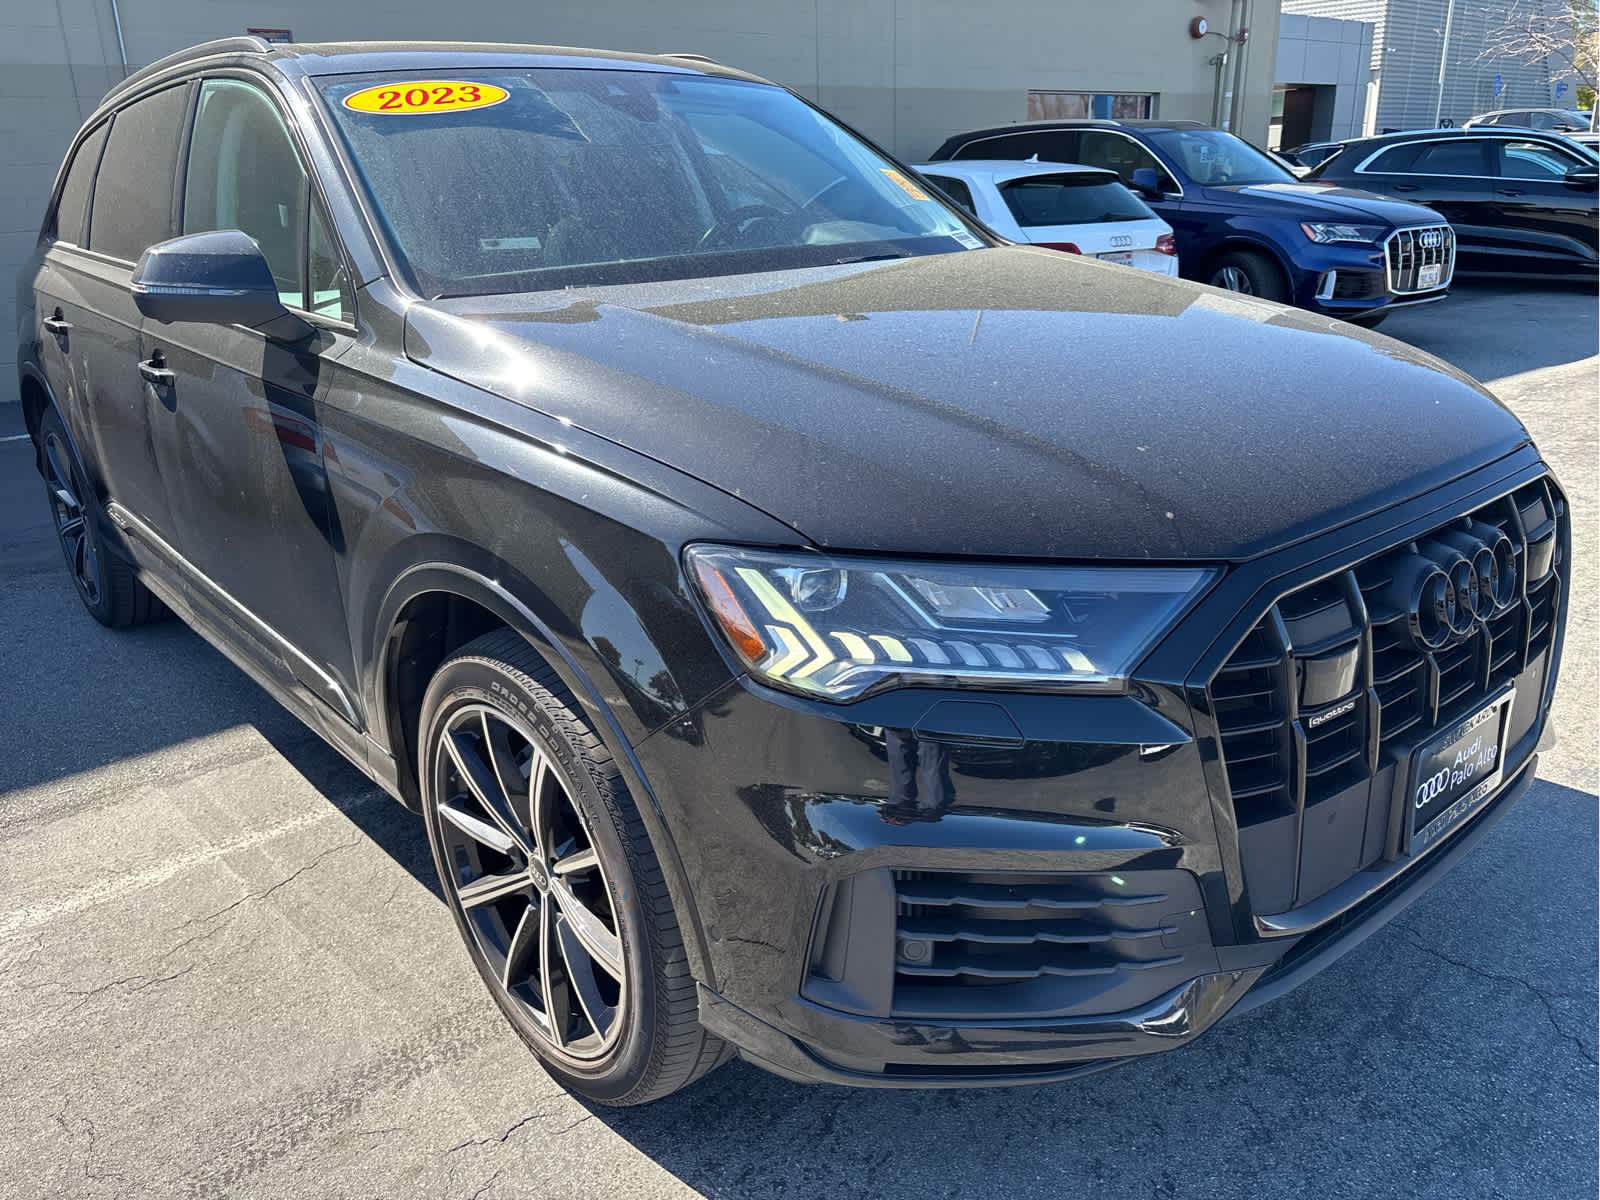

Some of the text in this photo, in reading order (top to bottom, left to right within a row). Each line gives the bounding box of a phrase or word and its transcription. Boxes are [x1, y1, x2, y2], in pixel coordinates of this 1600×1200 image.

[378, 86, 481, 109] 2023
[1311, 702, 1354, 726] quattro
[1453, 736, 1482, 768] Audi
[1450, 745, 1498, 790] Palo Alto
